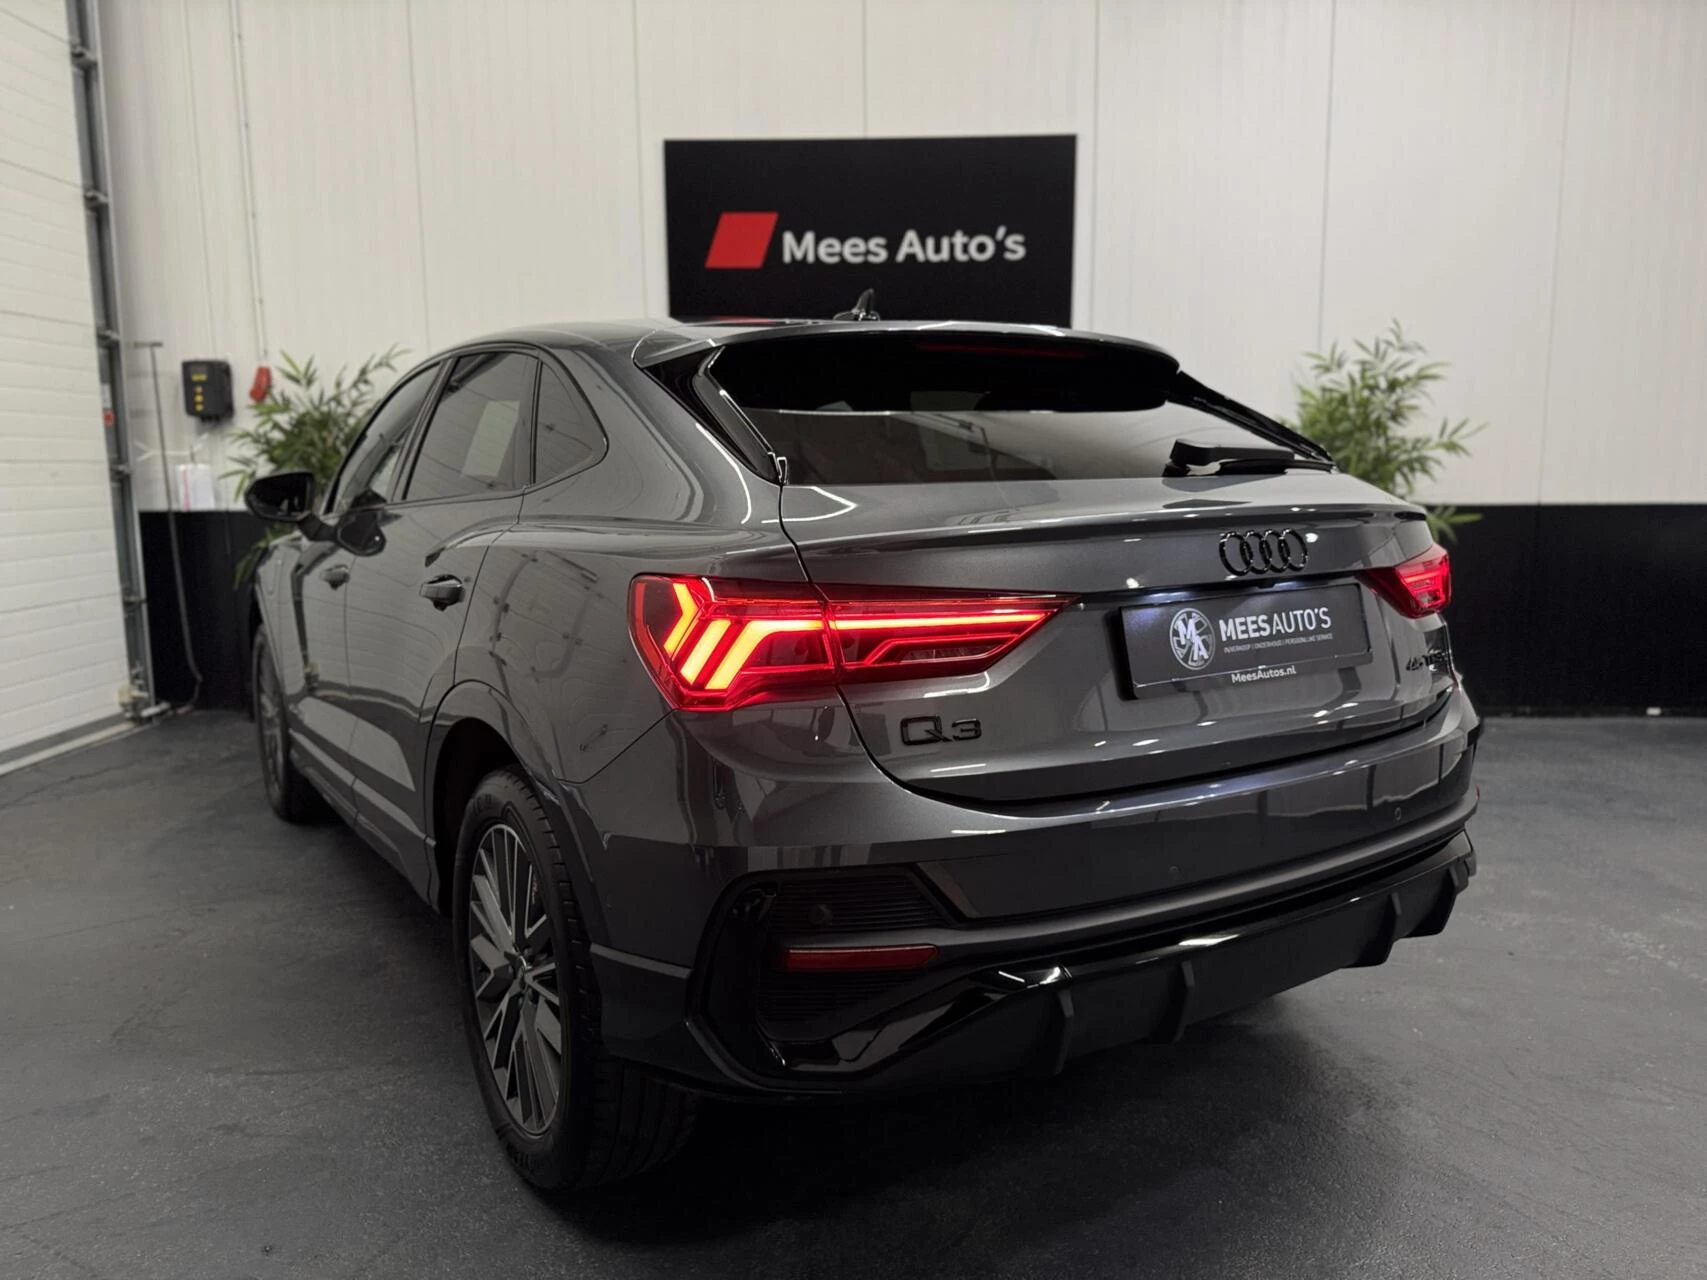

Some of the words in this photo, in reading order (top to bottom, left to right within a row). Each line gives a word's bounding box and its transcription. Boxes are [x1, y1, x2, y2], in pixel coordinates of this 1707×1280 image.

[782, 230, 888, 264] Mees
[895, 224, 1027, 263] Auto's
[1219, 614, 1271, 642] MEES
[1272, 607, 1332, 635] AUTO'S
[1231, 665, 1297, 684] MeesAutos.nl
[900, 714, 982, 746] Q3
